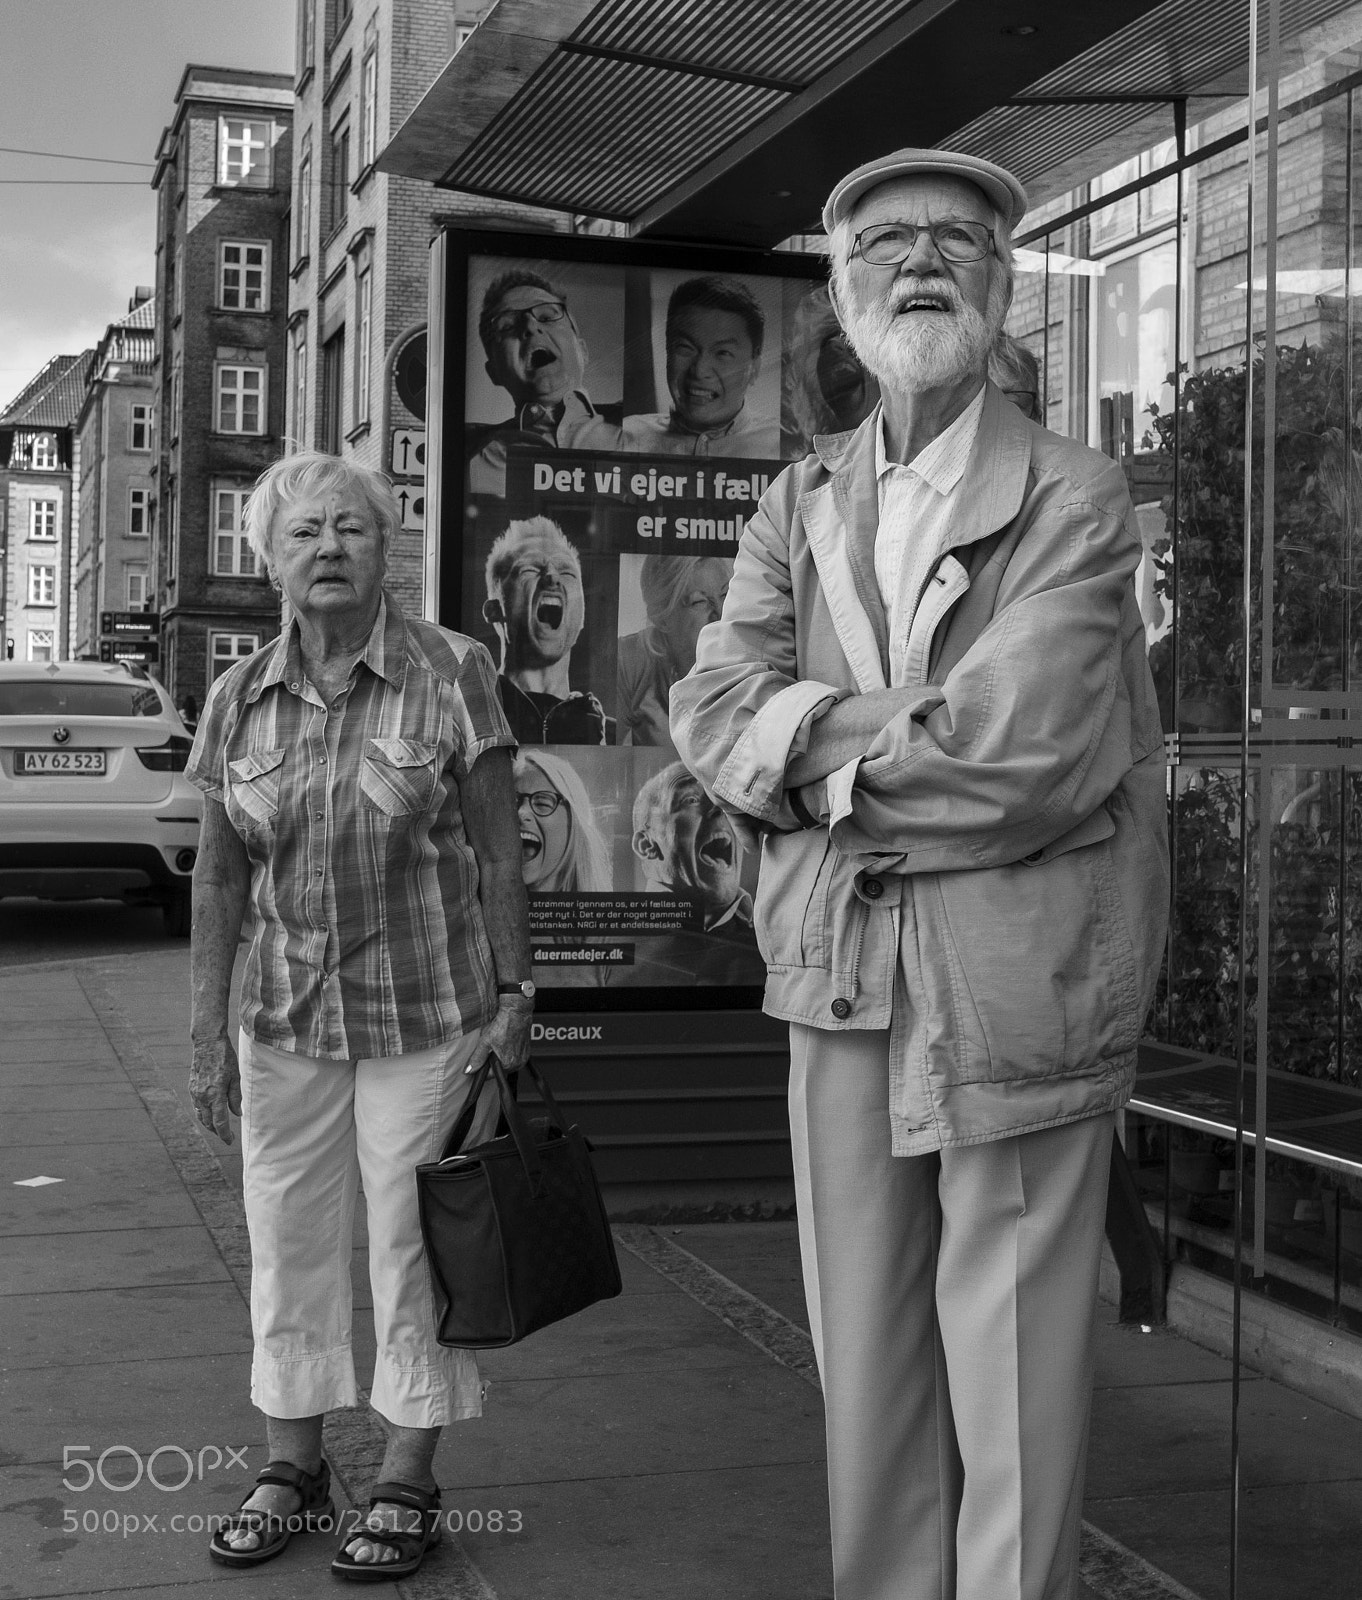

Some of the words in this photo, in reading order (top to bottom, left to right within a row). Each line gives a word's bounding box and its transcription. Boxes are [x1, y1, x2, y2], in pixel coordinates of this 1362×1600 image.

[534, 463, 585, 493] Det
[594, 466, 621, 494] vi
[630, 468, 688, 501] ejer
[696, 471, 705, 498] i
[636, 515, 667, 538] er
[26, 754, 48, 769] AY
[51, 754, 71, 769] 62
[74, 754, 103, 769] 523
[576, 900, 613, 910] igennem
[640, 900, 648, 908] vi
[650, 900, 676, 908] fælles
[528, 911, 553, 920] noget
[555, 911, 570, 920] nyt
[623, 911, 648, 920] noget
[649, 911, 687, 920] gammelt
[620, 921, 683, 929] andelsselskab.
[534, 948, 624, 962] duermedejer.dk
[530, 1023, 602, 1041] Decaux
